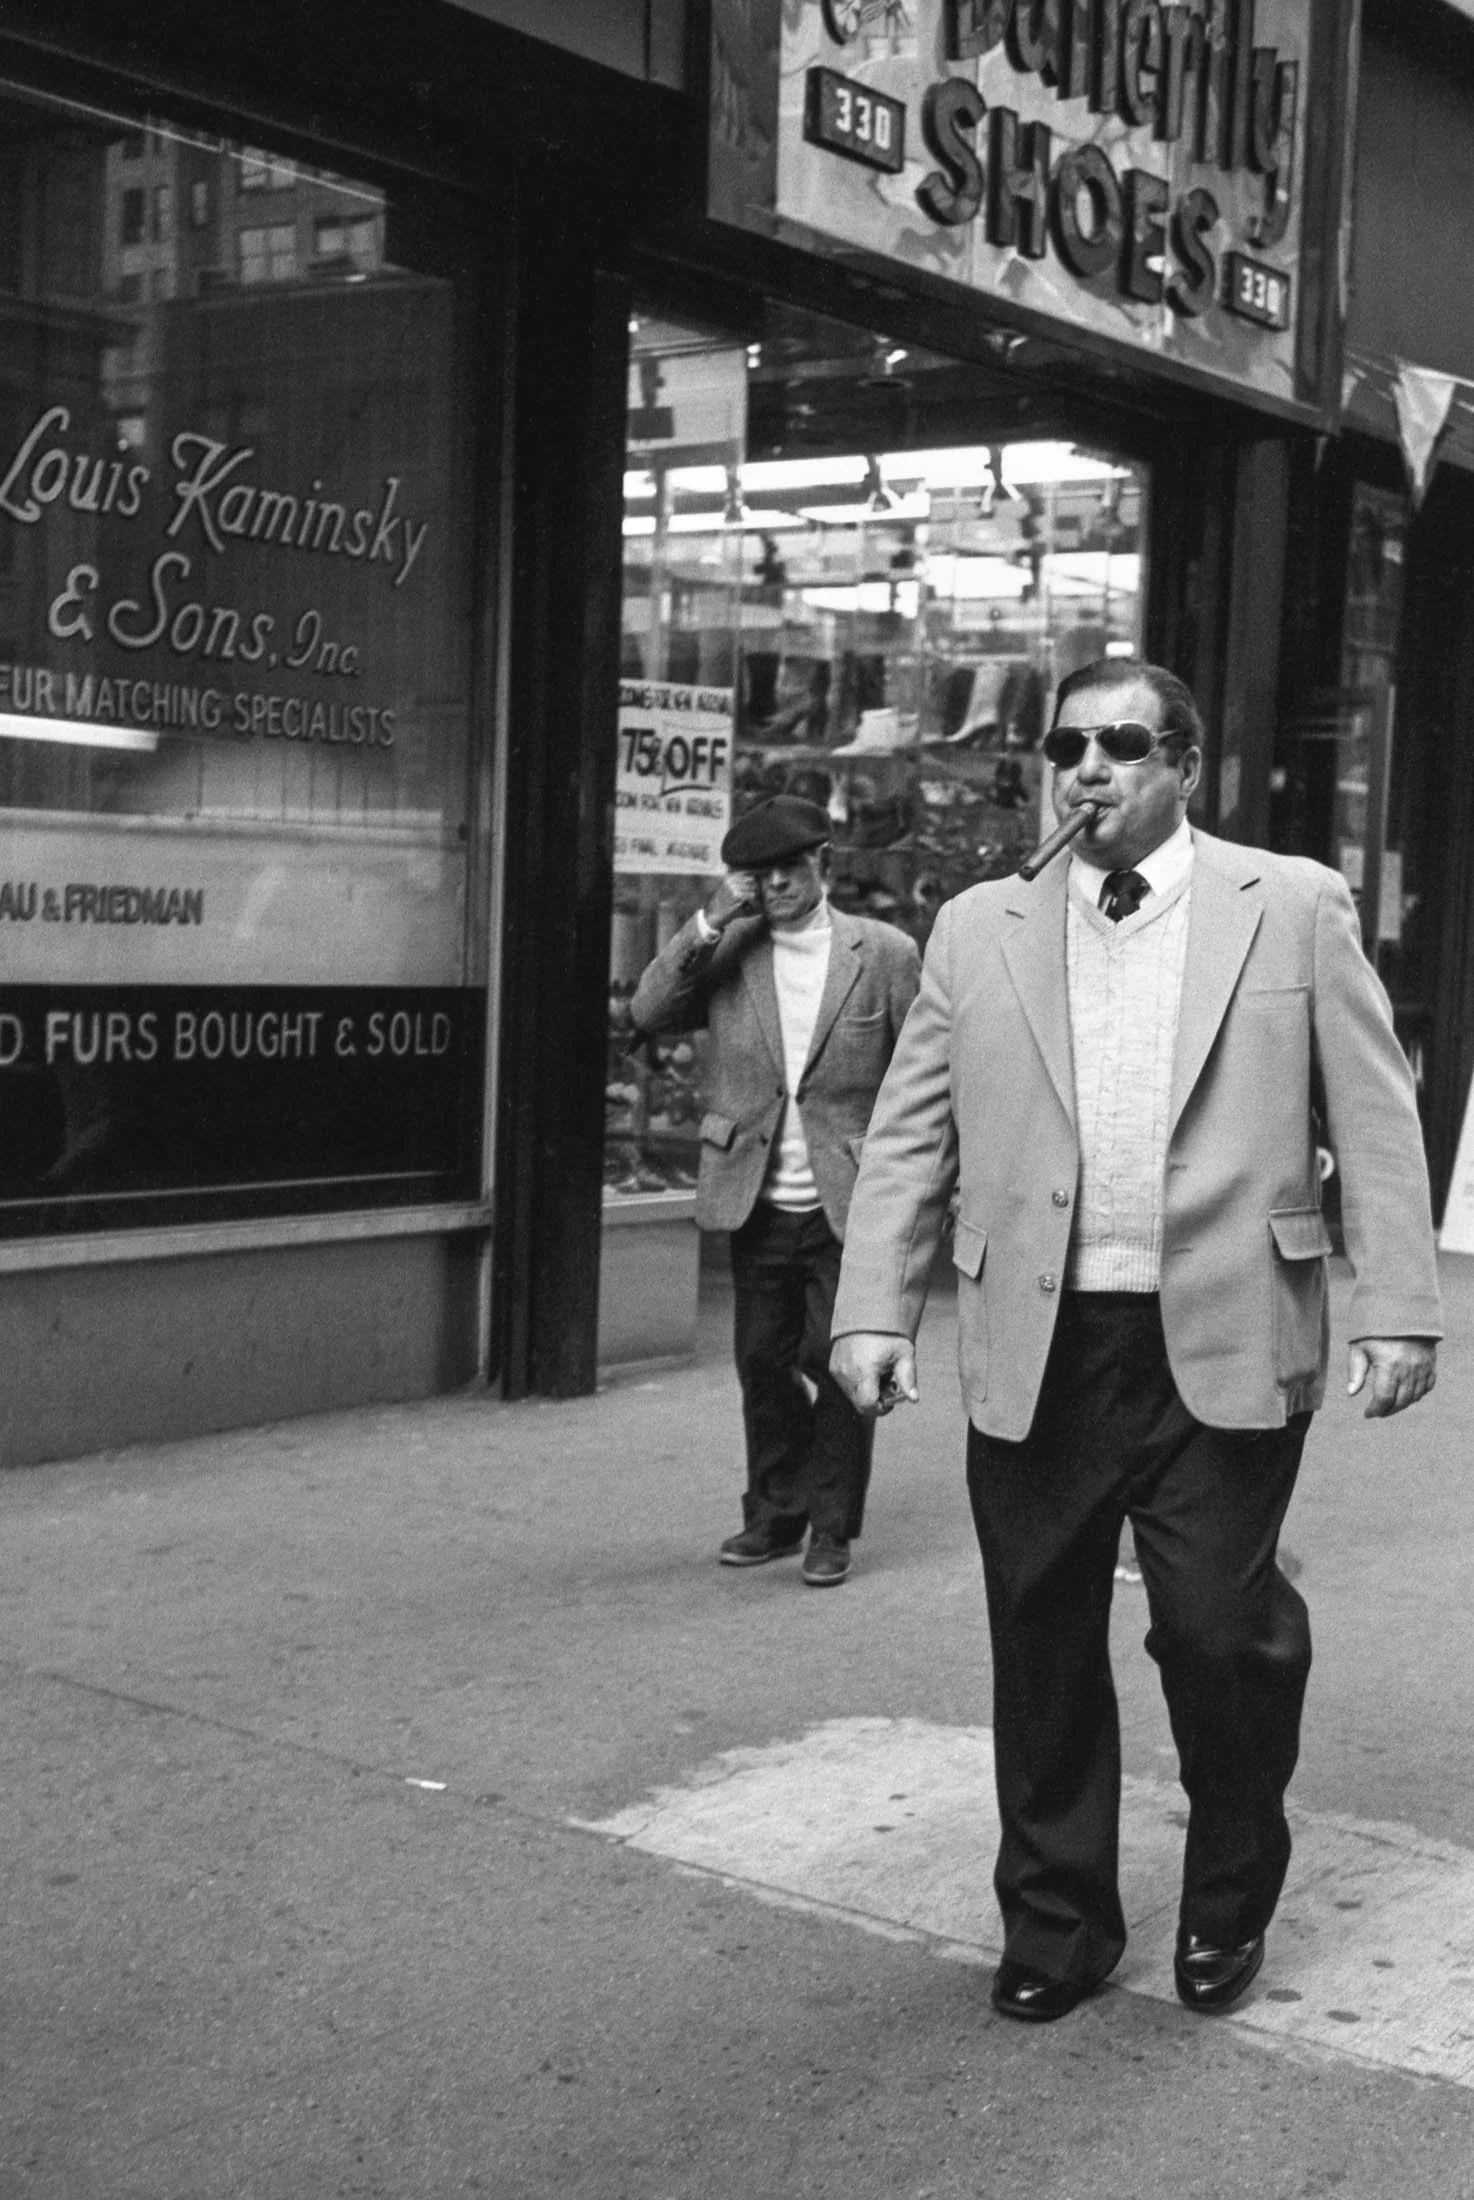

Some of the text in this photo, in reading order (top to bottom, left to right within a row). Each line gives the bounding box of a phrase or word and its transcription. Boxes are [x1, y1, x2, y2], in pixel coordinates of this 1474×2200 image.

[836, 87, 891, 150] 330
[914, 76, 1219, 318] SHOES
[1240, 266, 1280, 314] 330
[0, 406, 428, 586] Louis Kaminsky
[49, 564, 98, 640] &
[107, 552, 277, 668] Sons,
[65, 671, 222, 729] MATCHING
[234, 692, 396, 747] SPECIALISTS
[664, 735, 726, 782] OFF
[41, 887, 60, 923] &
[64, 883, 204, 926] FRIEDMAN
[46, 1011, 158, 1065] FURS
[174, 1011, 324, 1060] BOUGHT
[335, 1016, 356, 1056] &
[367, 1010, 451, 1056] SOLD
